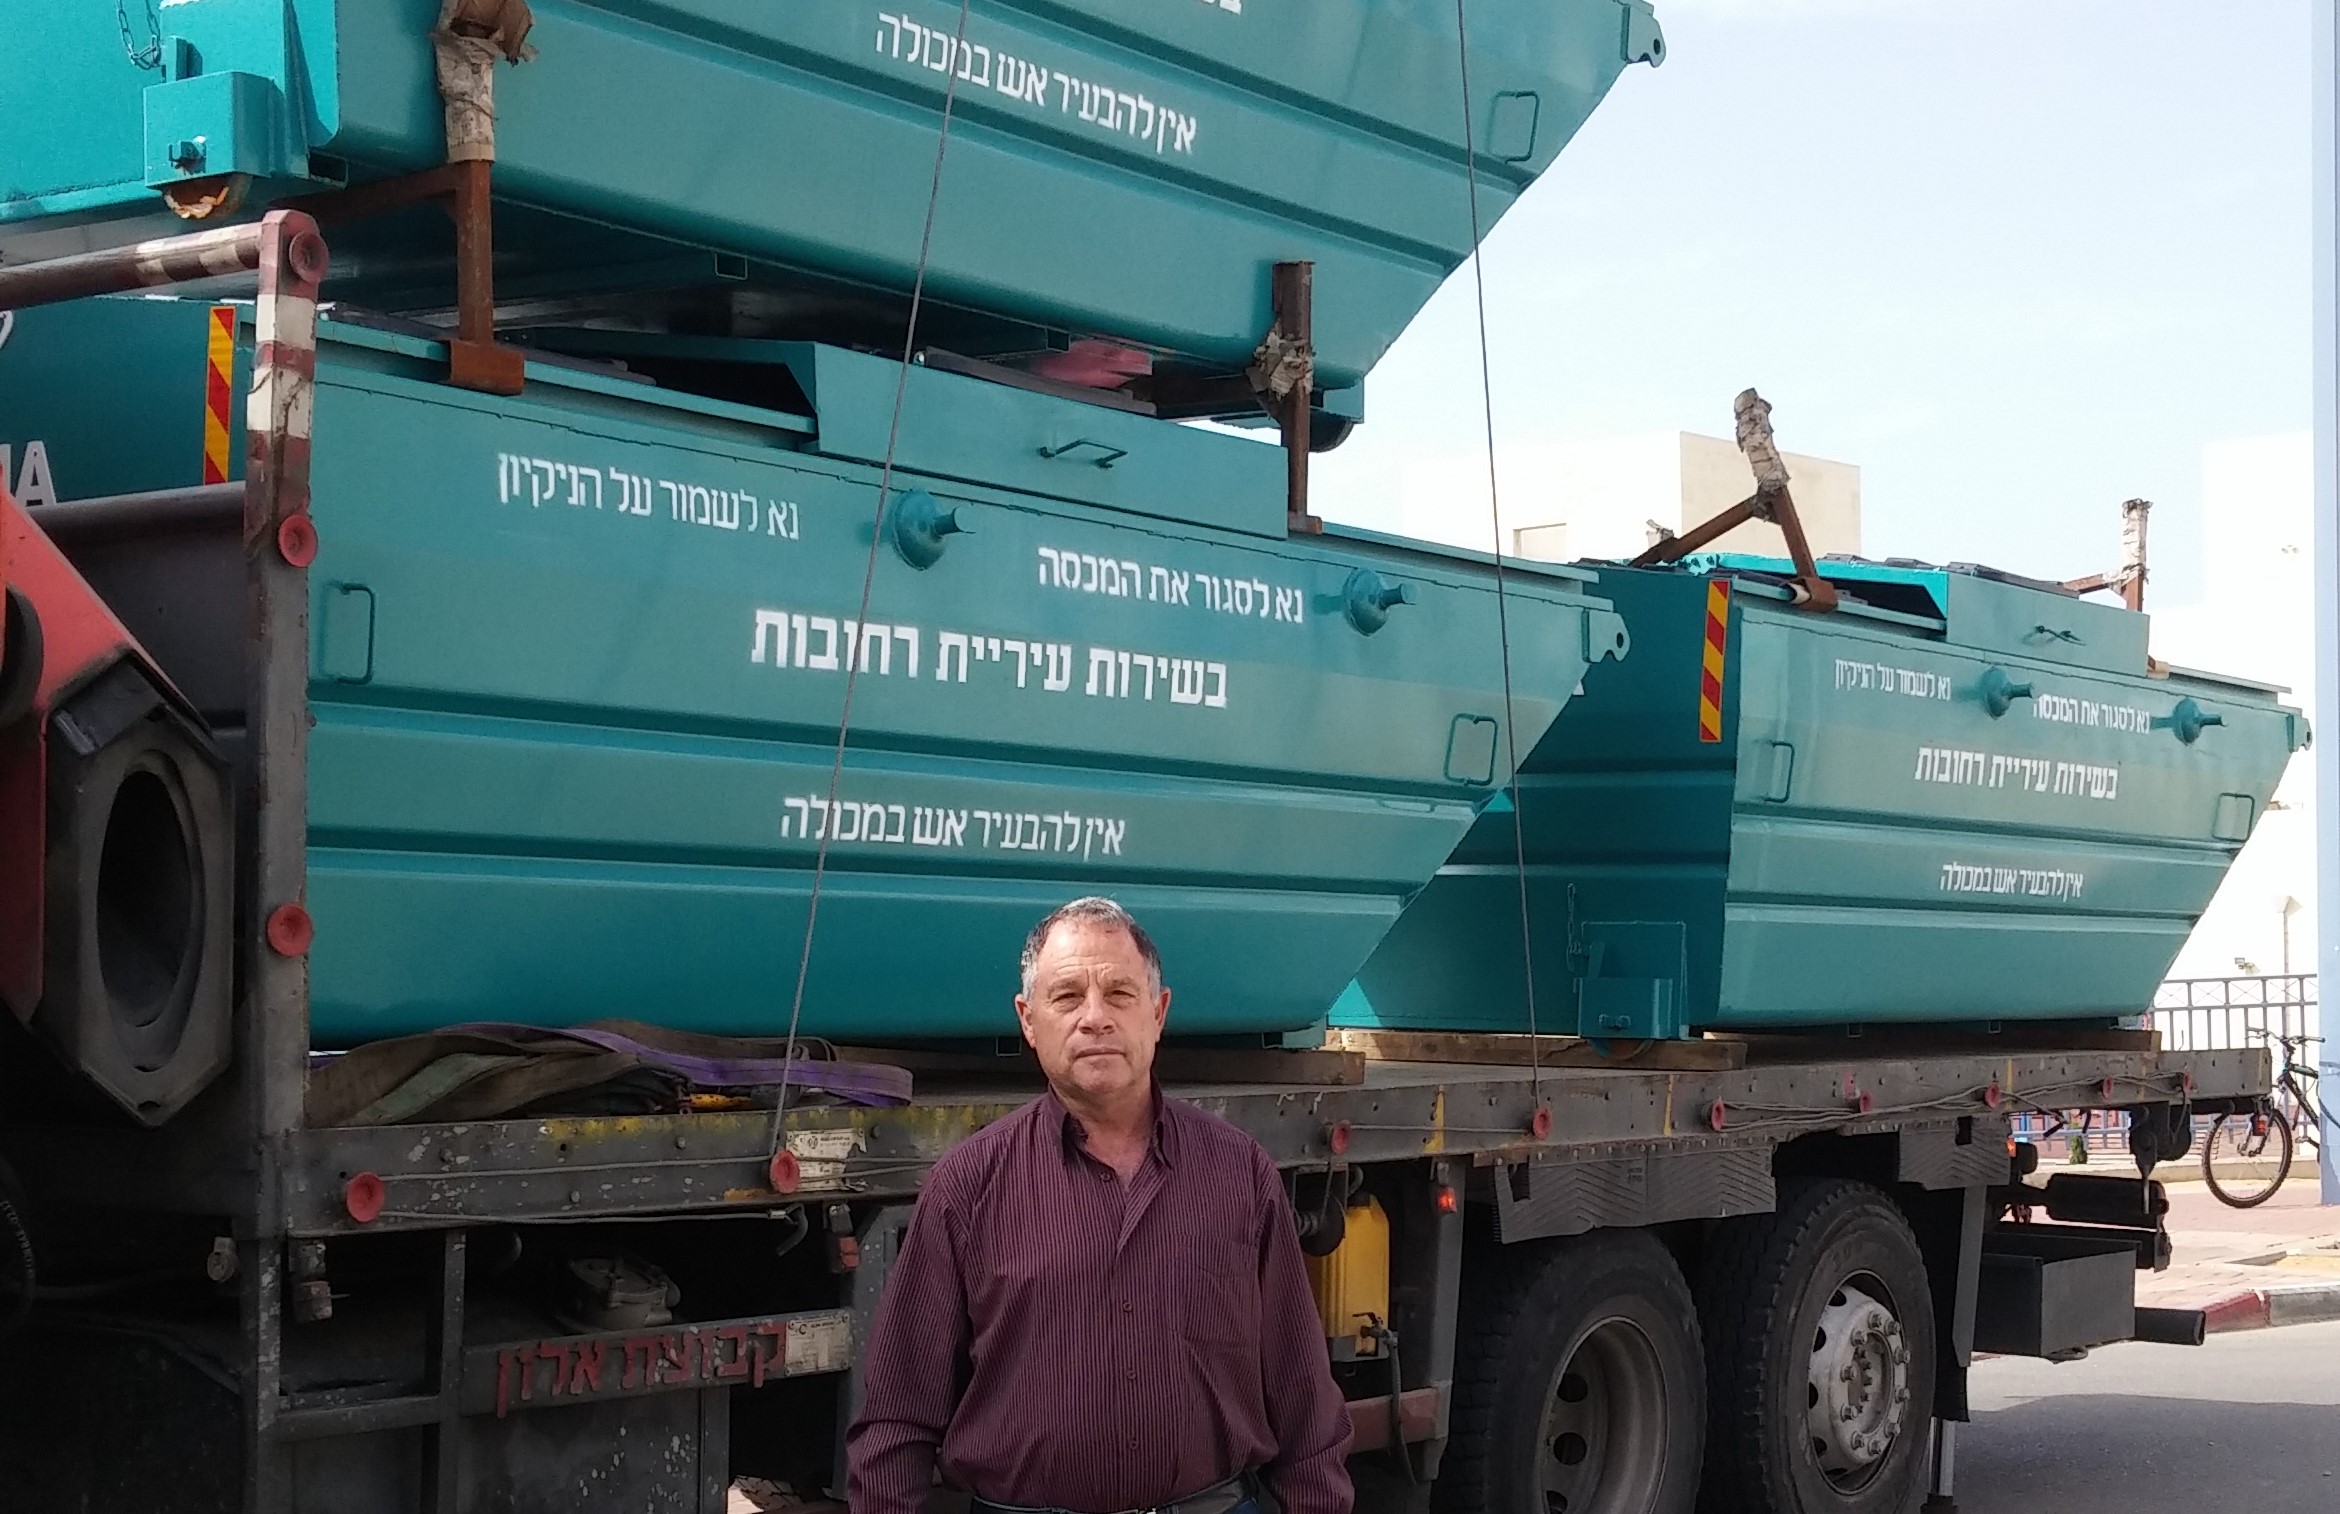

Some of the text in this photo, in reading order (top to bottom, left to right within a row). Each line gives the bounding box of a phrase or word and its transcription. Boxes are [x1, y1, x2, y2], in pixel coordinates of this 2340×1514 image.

[876, 12, 991, 88] במכולה
[996, 52, 1048, 106] אש
[498, 453, 799, 540] נא לשמור על הניקיון
[1038, 546, 1303, 624] נא לסגור את המכסה
[751, 608, 1227, 708] בשירות עיריית רחובות
[1876, 662, 1895, 692] על
[1937, 675, 1951, 701] נא
[2080, 700, 2100, 726] את
[2100, 703, 2136, 732] לסגור
[2136, 709, 2150, 735] נא
[1914, 747, 1986, 786] רחובות
[1988, 754, 2051, 792] עיריית
[781, 794, 906, 843] במכולה
[912, 806, 968, 847] אש
[1940, 861, 1993, 892] במכולה
[1992, 867, 2018, 893] אש
[621, 1318, 787, 1389] קבוצת
